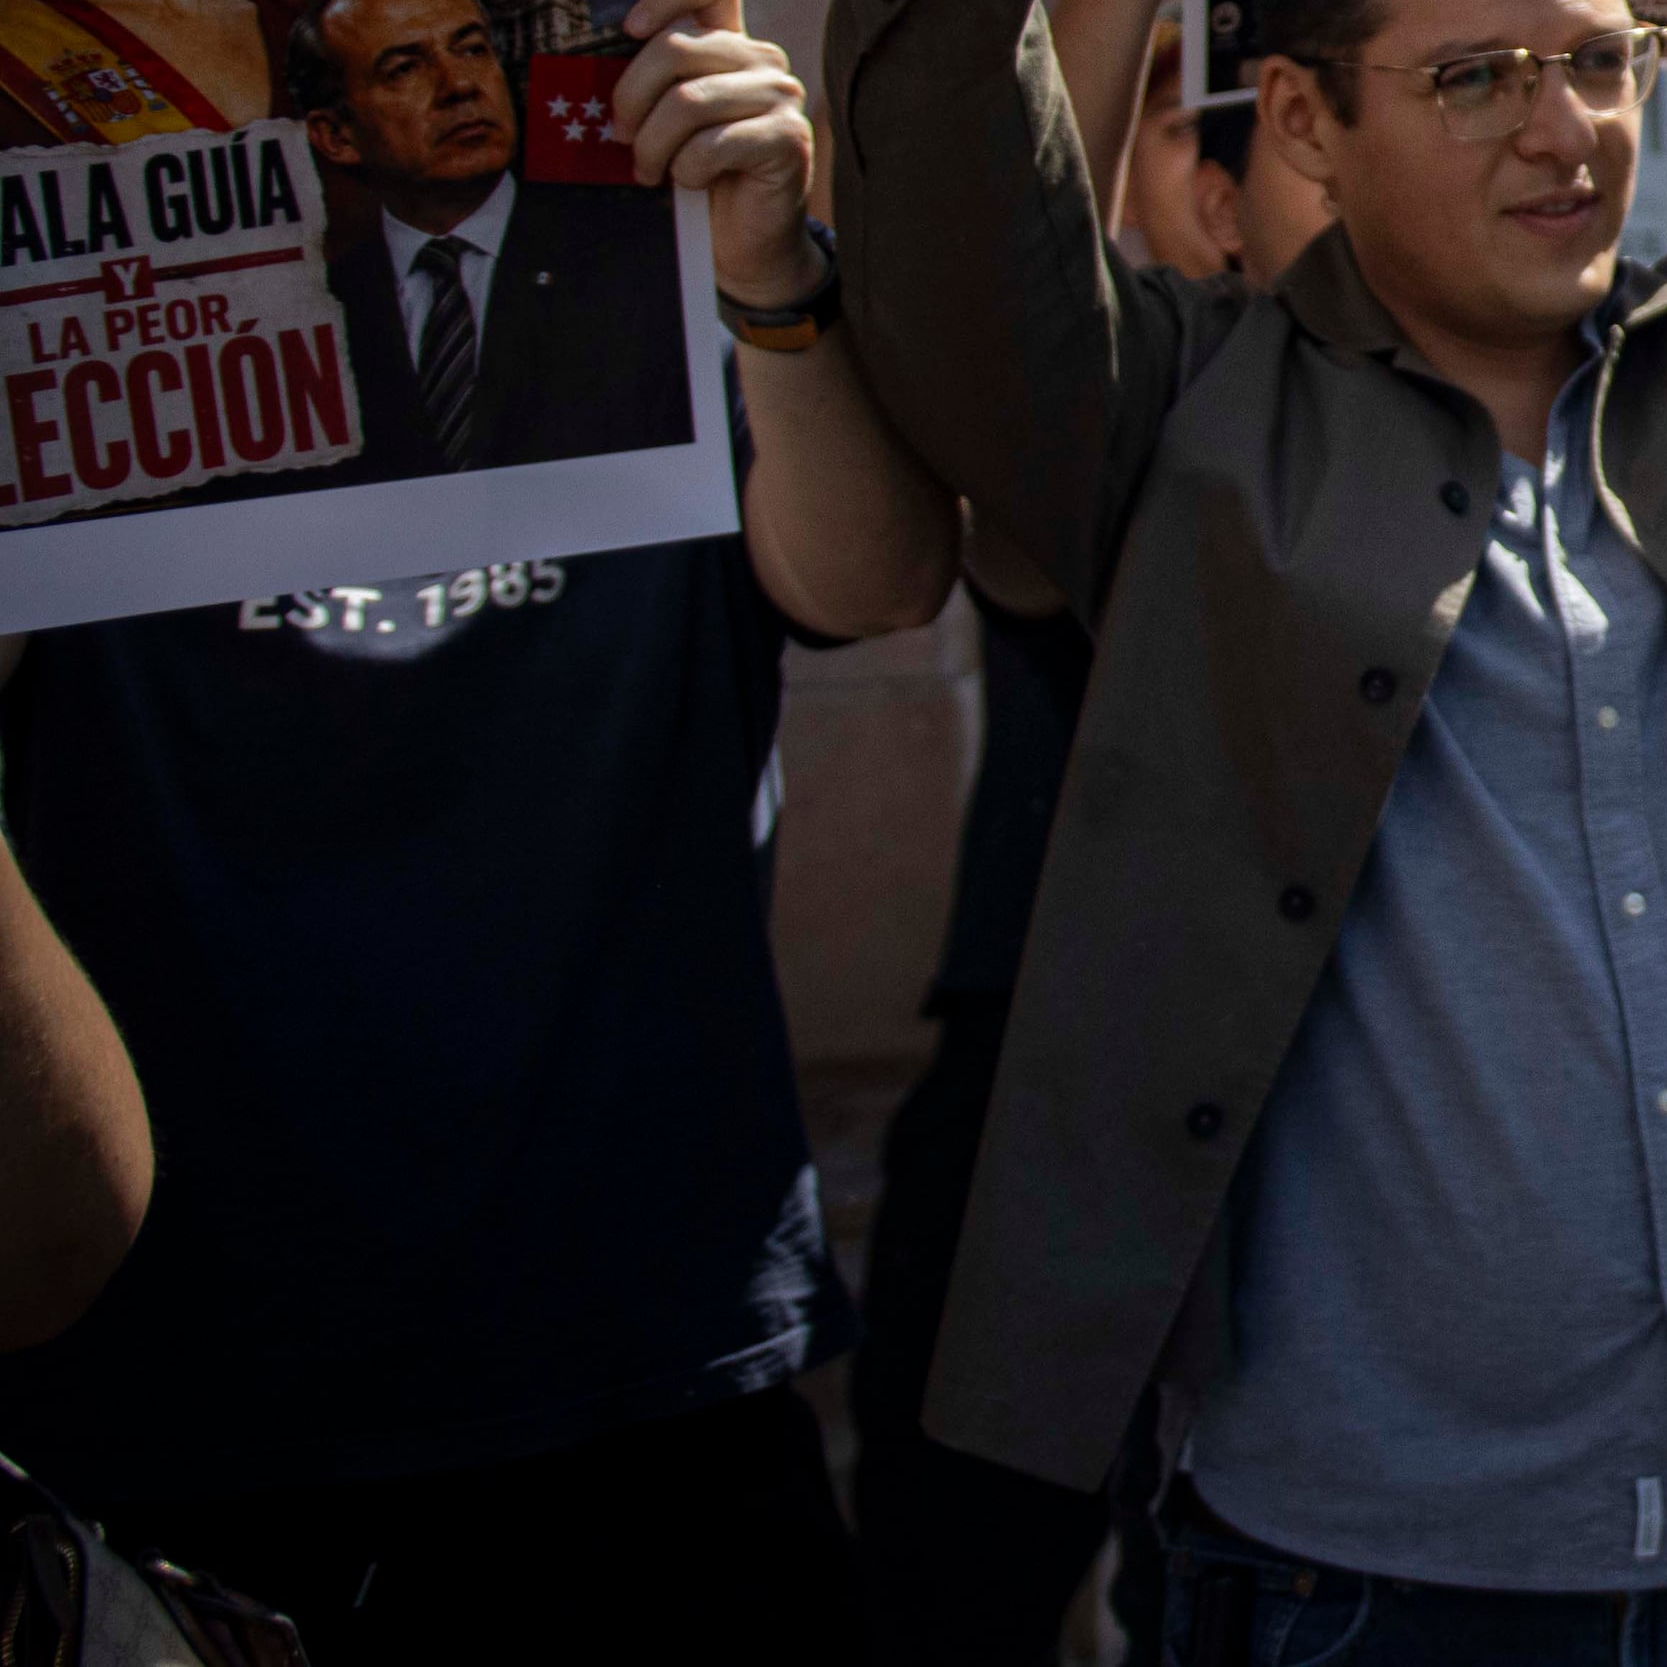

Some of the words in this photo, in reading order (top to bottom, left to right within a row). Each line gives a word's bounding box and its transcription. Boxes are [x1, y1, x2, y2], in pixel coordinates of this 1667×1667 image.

[143, 130, 304, 244] GUÍA
[111, 259, 141, 296] Y
[27, 315, 93, 365] LA
[103, 292, 234, 354] PEOR
[0, 317, 350, 508] ECCIÓN
[238, 584, 398, 635] EST.
[415, 557, 568, 630] 1985
